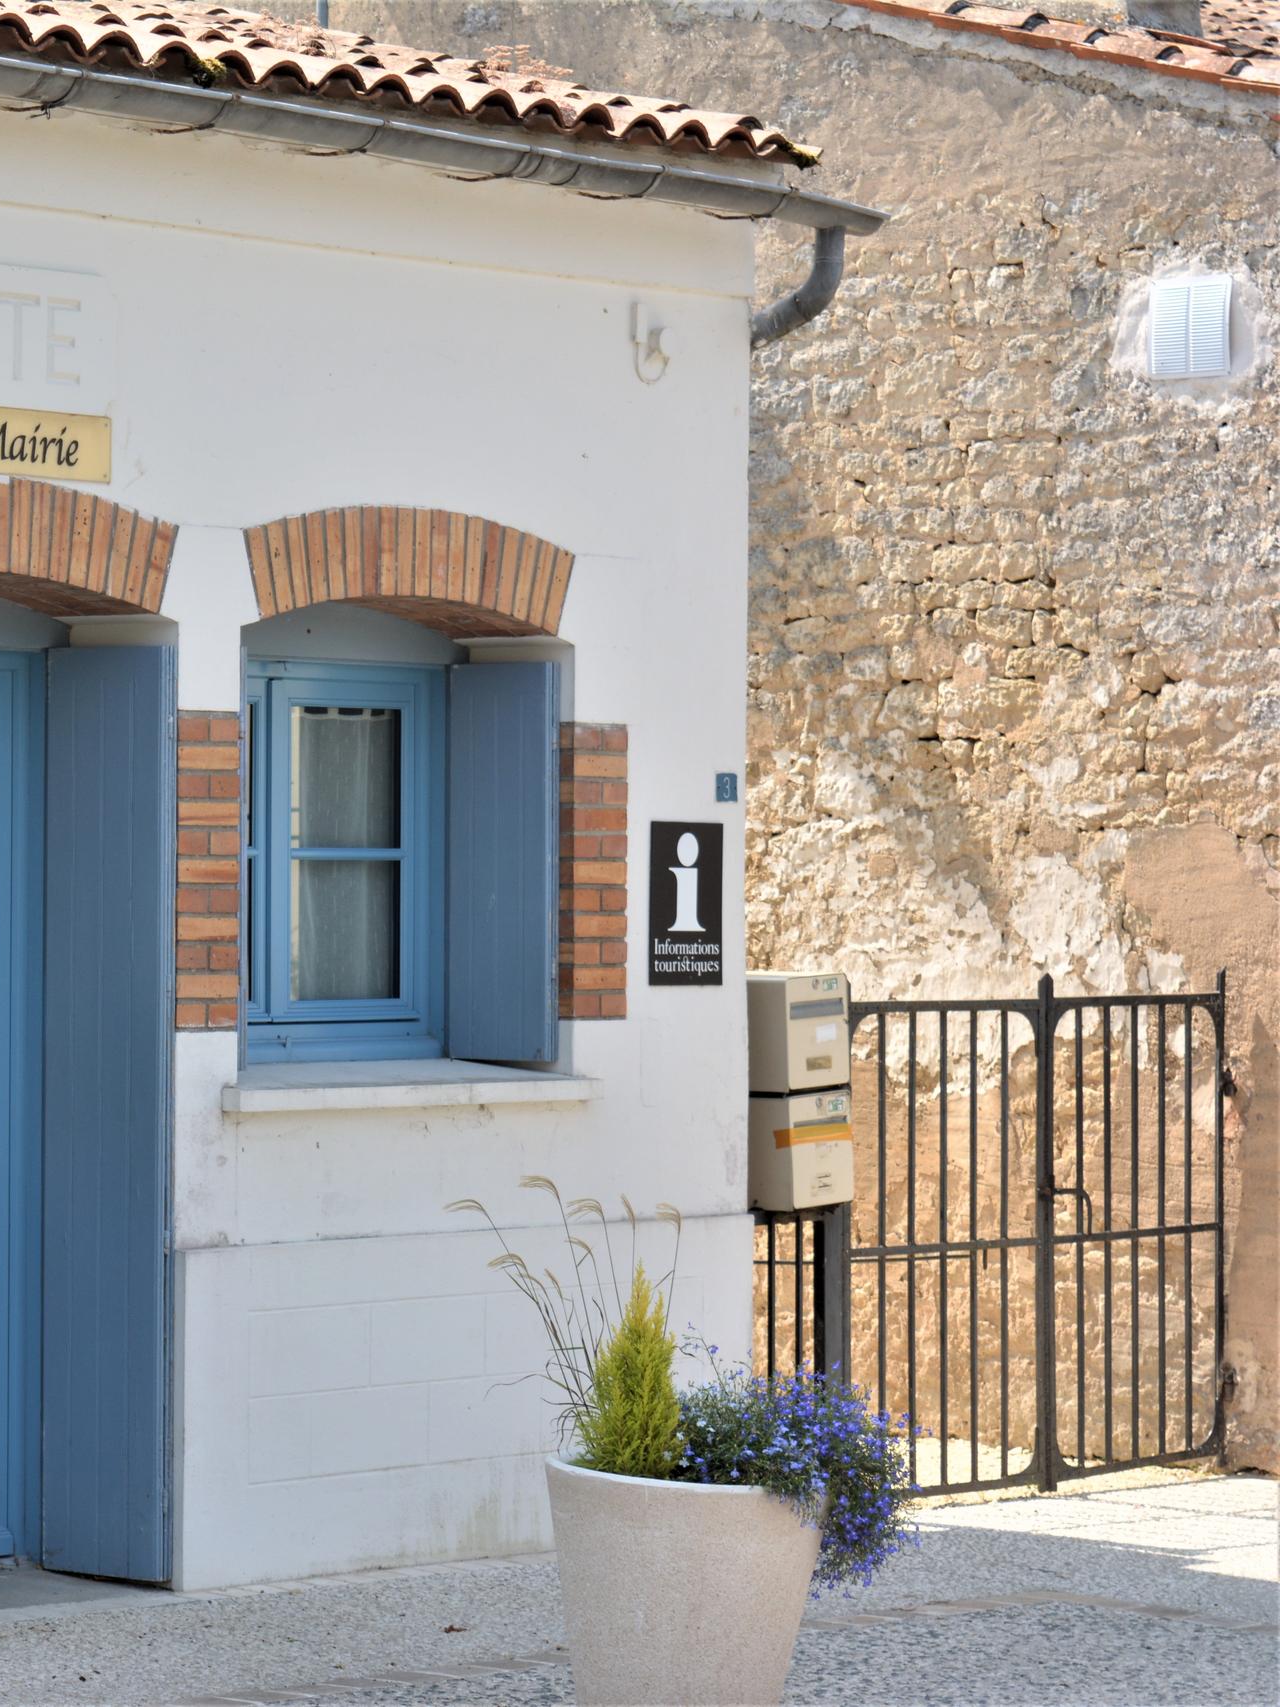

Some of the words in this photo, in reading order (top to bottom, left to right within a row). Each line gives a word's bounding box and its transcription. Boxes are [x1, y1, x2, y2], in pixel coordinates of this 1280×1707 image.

[723, 776, 730, 798] 3
[654, 938, 720, 955] Informations
[654, 956, 719, 976] touristiques
